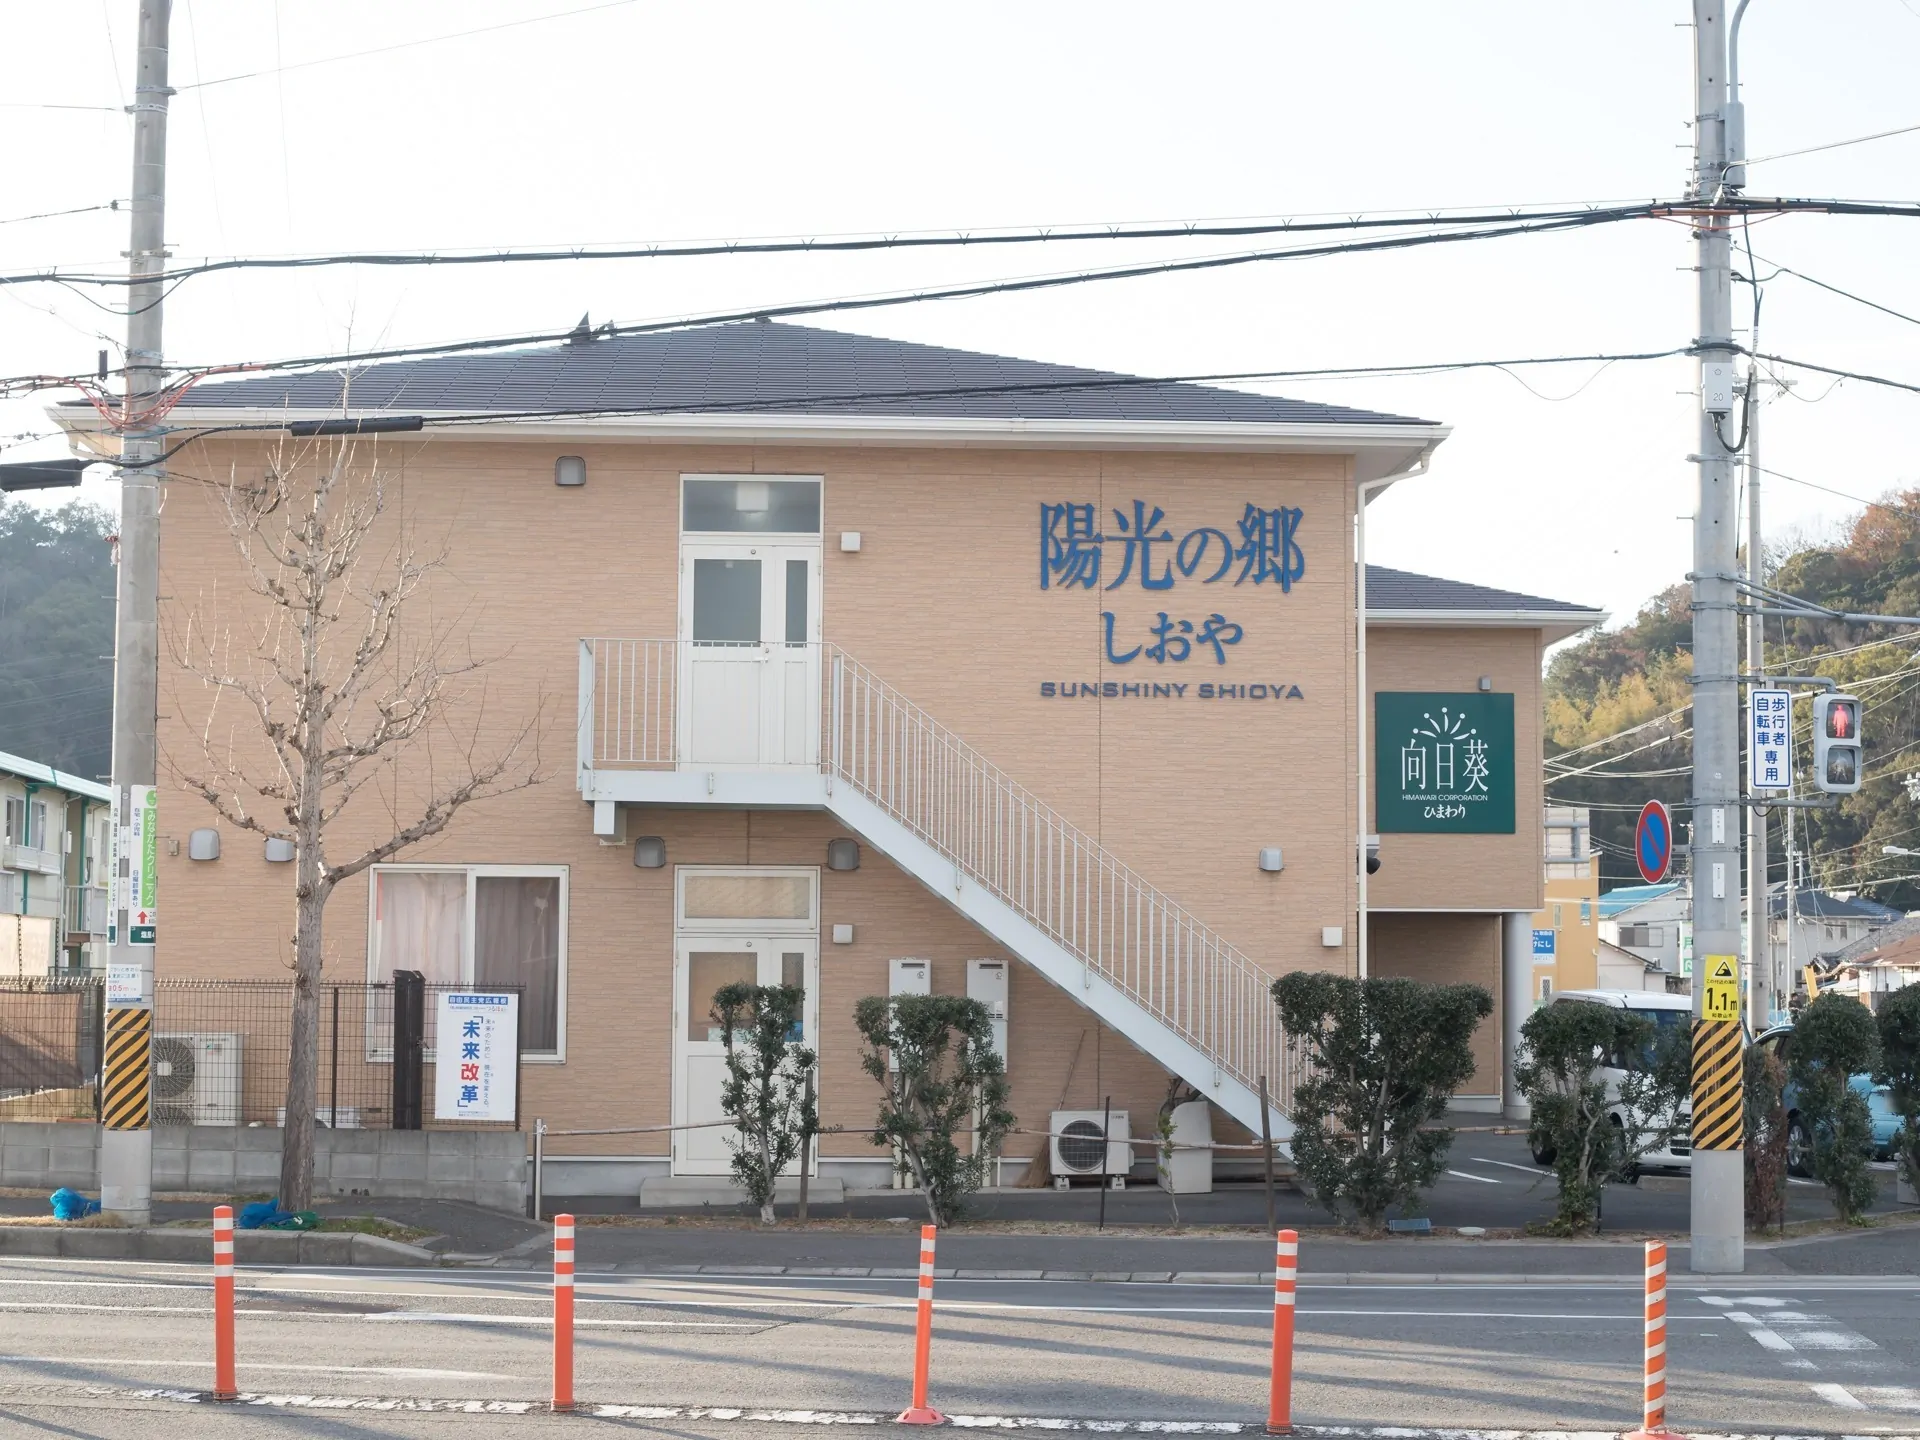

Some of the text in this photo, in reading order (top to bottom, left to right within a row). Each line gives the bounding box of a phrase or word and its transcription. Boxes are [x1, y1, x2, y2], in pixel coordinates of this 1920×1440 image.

[1713, 392, 1724, 402] 20
[1040, 500, 1305, 593] 陽光の郷
[1101, 611, 1243, 665] しおや
[1040, 682, 1304, 700] SUNSHINY SHIOYA
[1756, 697, 1770, 746] 自転車
[1772, 697, 1786, 746] 歩行者
[1402, 738, 1490, 793] 向日葵
[1764, 749, 1779, 782] 専用
[1424, 803, 1466, 819] ひまわり
[449, 996, 508, 1005] 自由民主党広報板
[1706, 987, 1738, 1011] 1.1m
